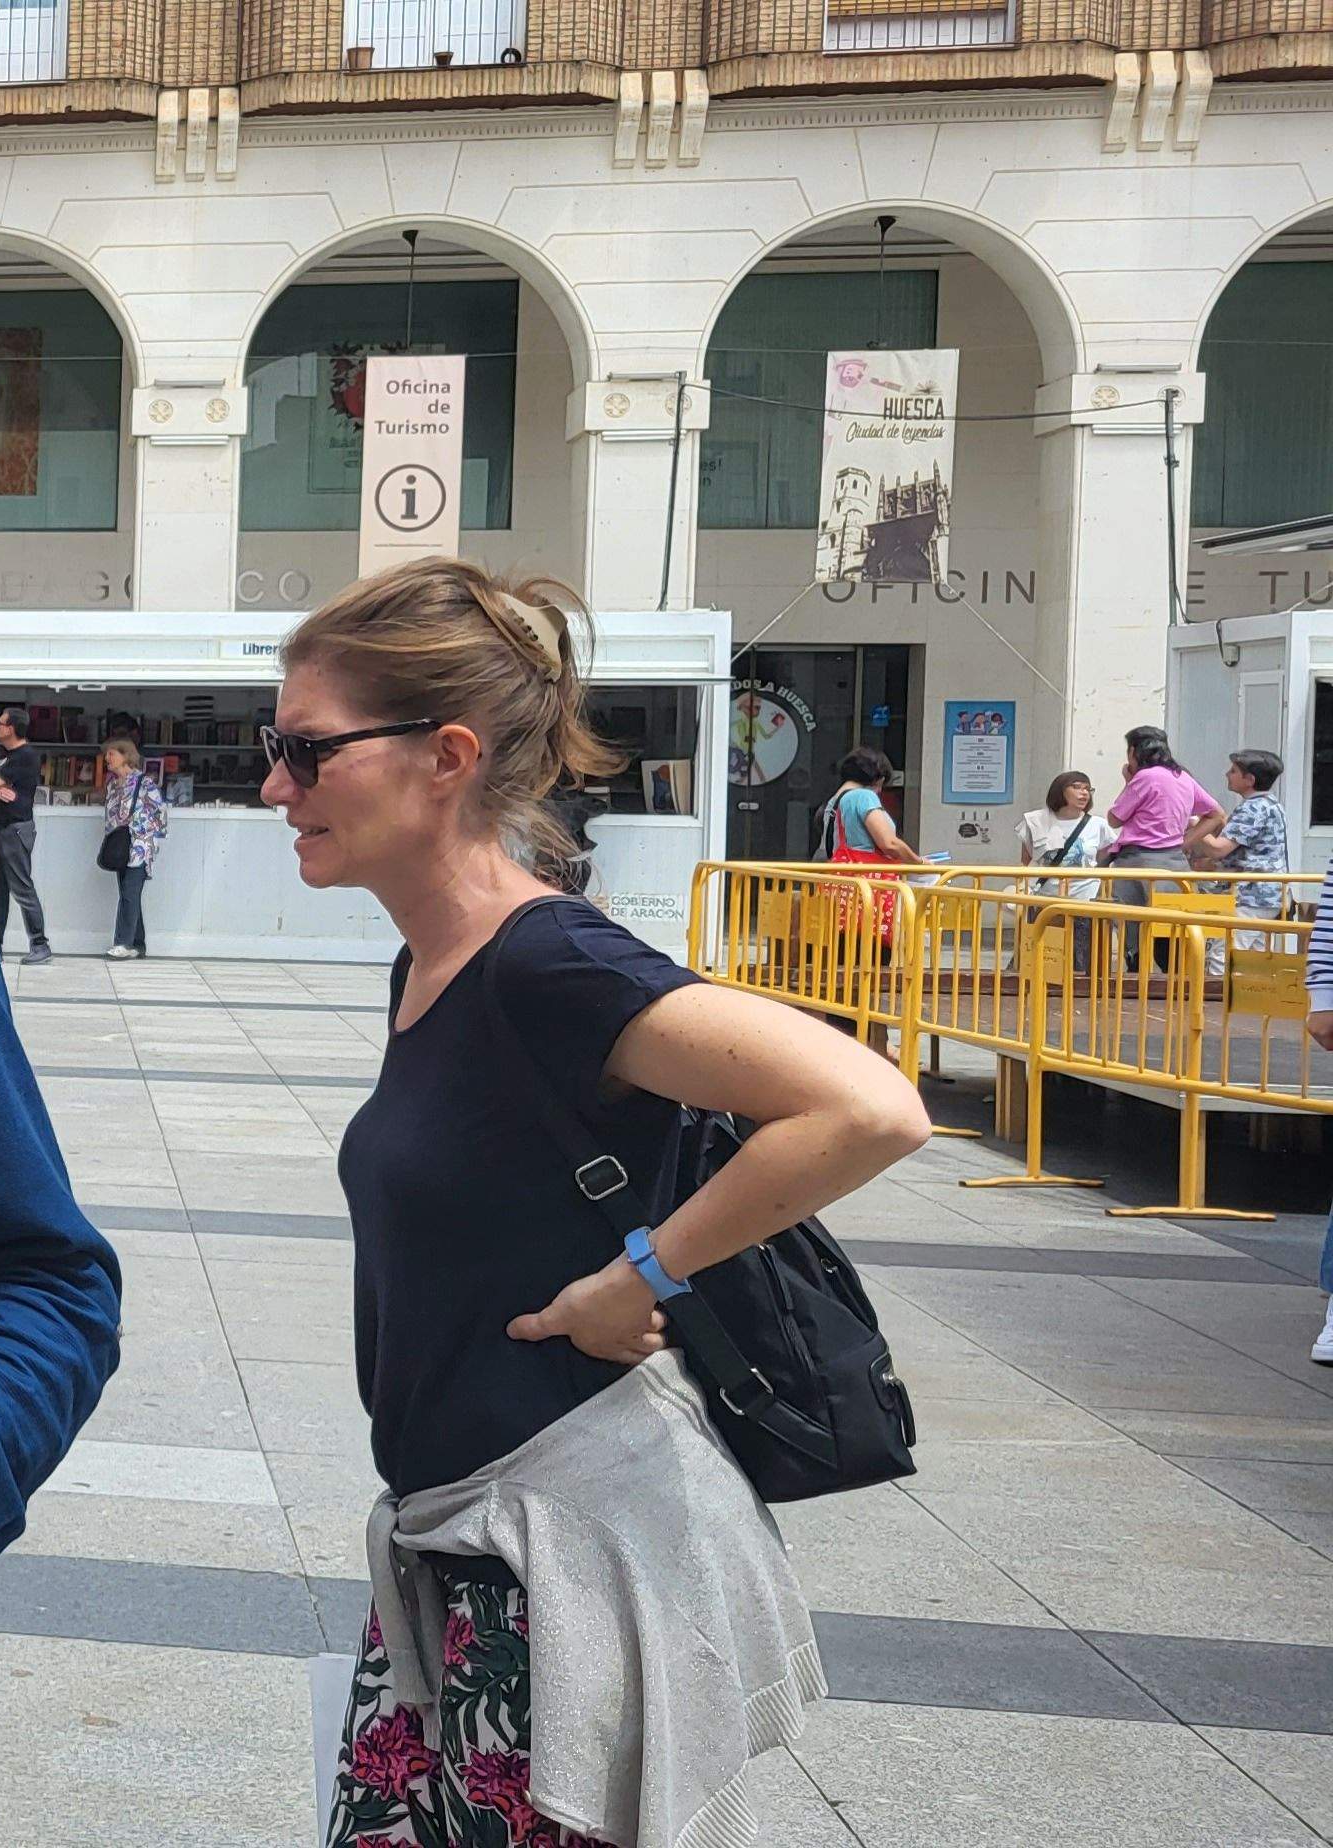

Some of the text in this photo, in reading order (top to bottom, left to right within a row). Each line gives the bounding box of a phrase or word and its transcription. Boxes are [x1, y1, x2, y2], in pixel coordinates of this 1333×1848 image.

[385, 379, 452, 395] Oficina
[427, 399, 451, 415] de
[883, 397, 945, 420] HUESCA
[374, 419, 450, 435] Turismo
[845, 421, 946, 445] Ciudad de leyendas
[822, 570, 1036, 604] OFICIN
[1259, 571, 1333, 605] TU
[242, 642, 279, 657] Librer
[776, 686, 817, 733] HUESCA
